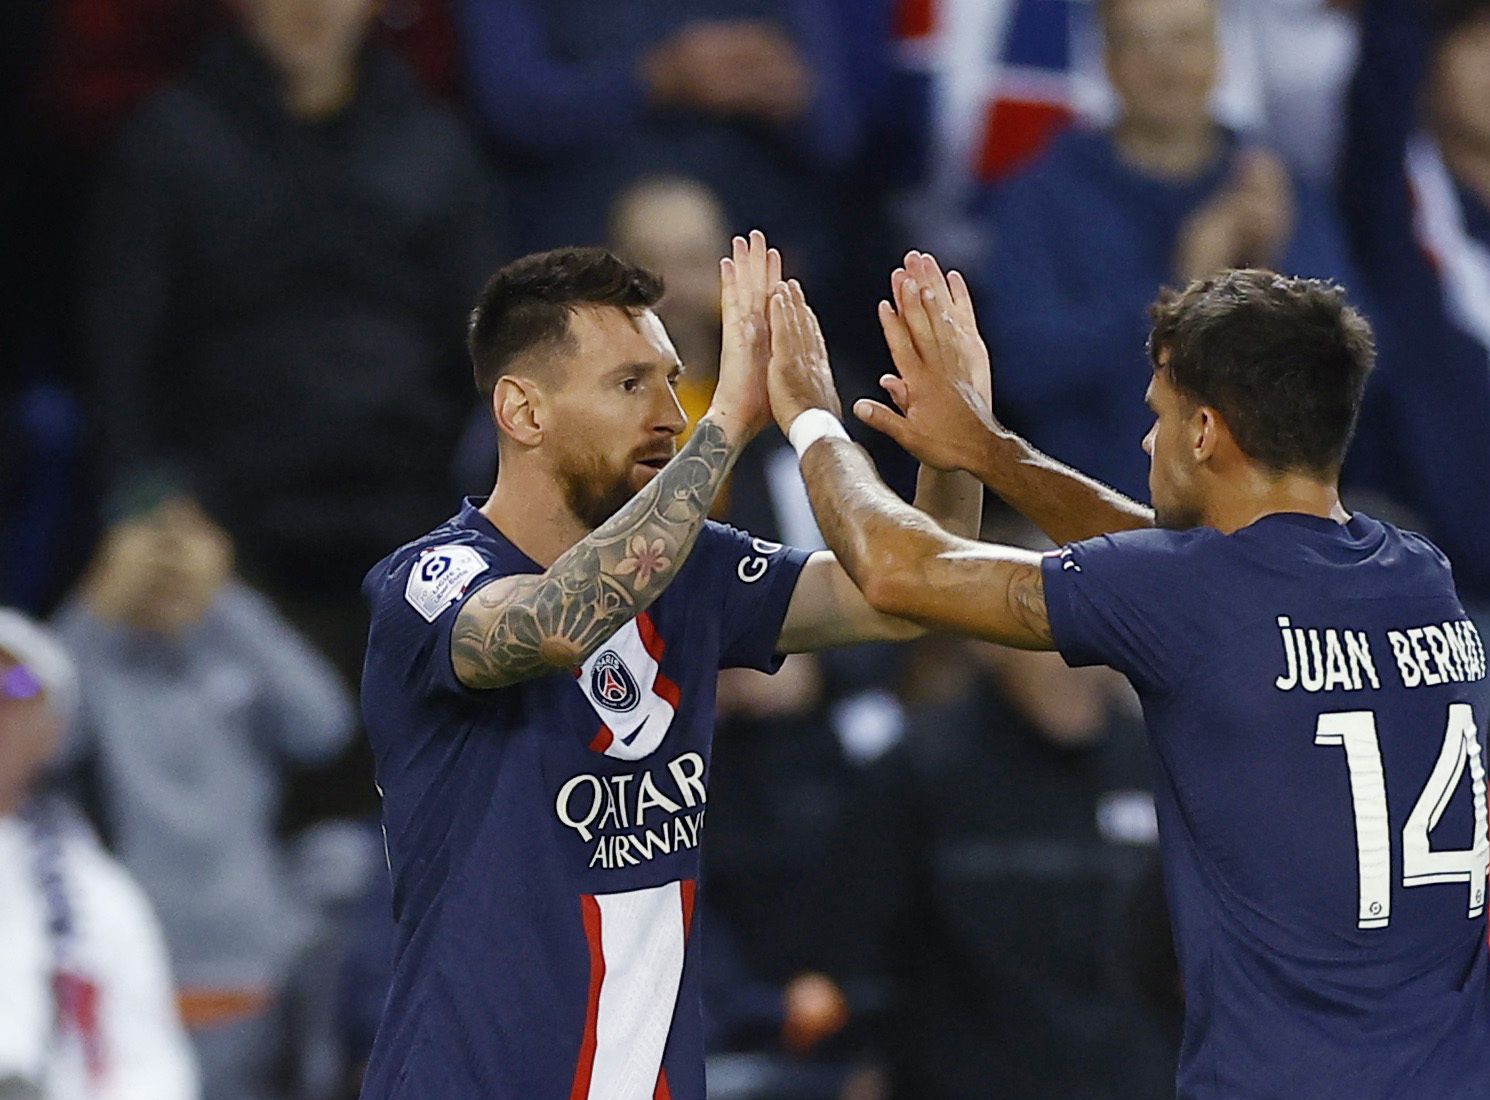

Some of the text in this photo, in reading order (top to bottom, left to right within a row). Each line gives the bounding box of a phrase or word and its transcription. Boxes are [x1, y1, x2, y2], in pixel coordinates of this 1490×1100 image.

[556, 752, 706, 842] QATAR
[588, 810, 706, 868] AIRWAY
[1314, 703, 1490, 929] 14
